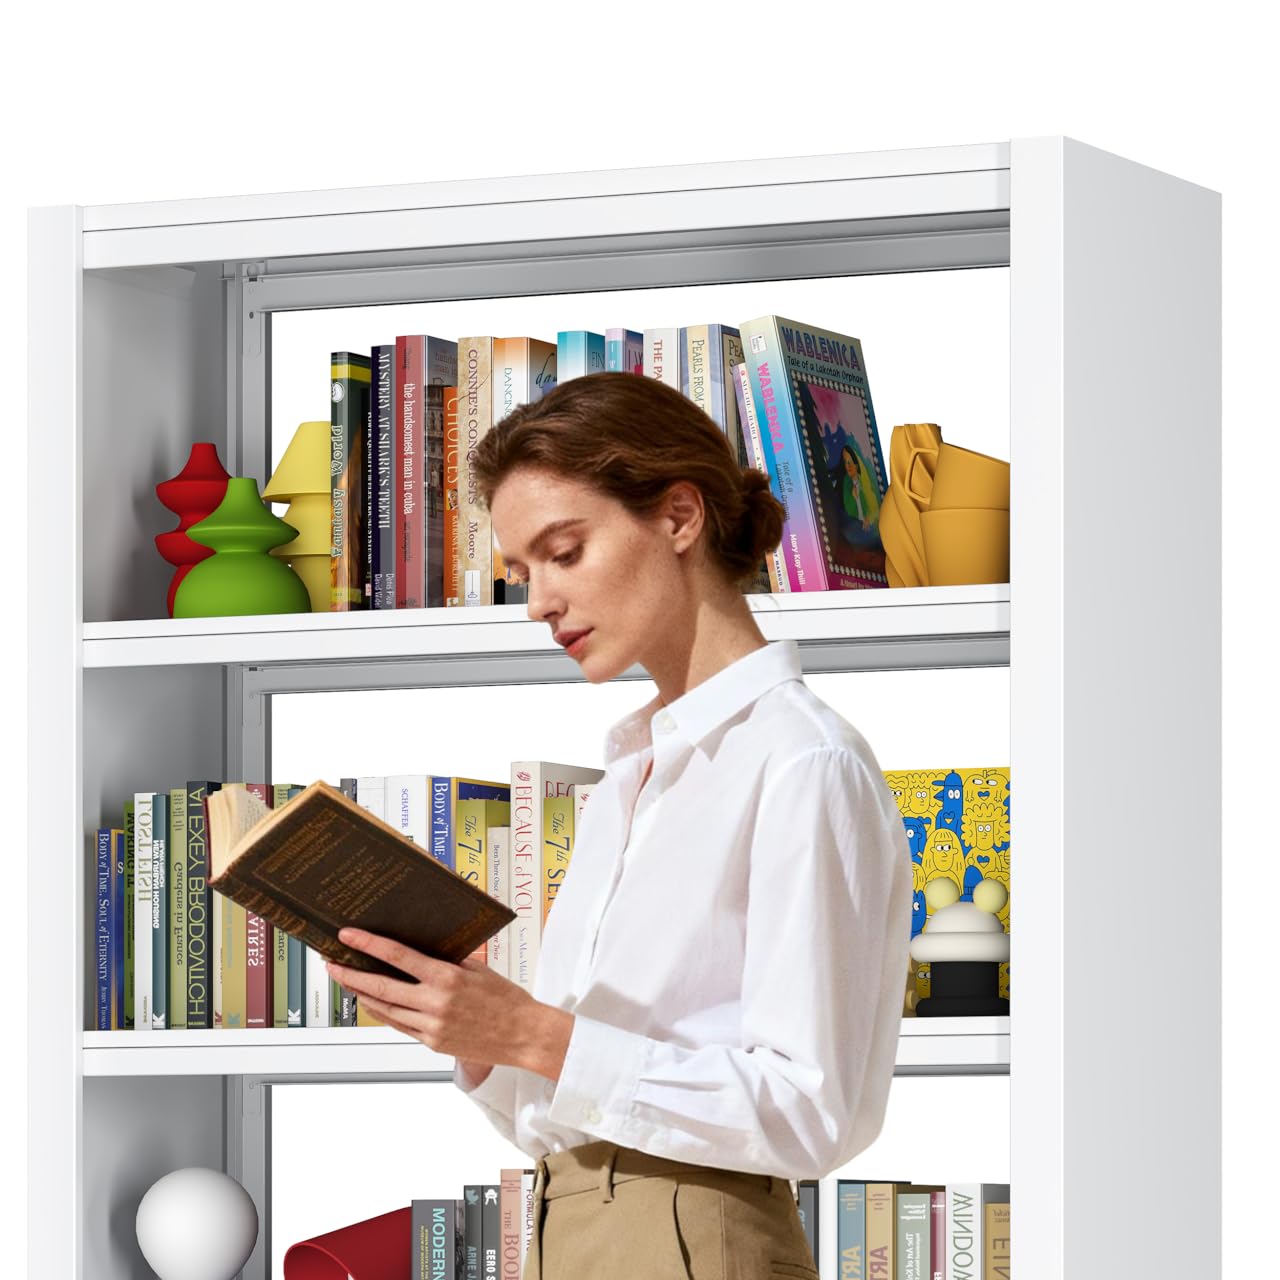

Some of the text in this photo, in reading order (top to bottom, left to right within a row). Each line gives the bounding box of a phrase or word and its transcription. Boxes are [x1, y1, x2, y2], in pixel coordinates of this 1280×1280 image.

[781, 326, 860, 371] WABLENICA
[788, 358, 800, 368] Tale
[692, 340, 703, 399] PEARLS FROM
[404, 383, 415, 515] the handsomest man in cuba
[469, 522, 477, 559] Moore
[515, 786, 532, 862] BECAUSE
[100, 833, 109, 857] BODY
[100, 900, 109, 925] SOUL
[100, 935, 109, 981] ETERNITY
[486, 1249, 496, 1273] EERO
